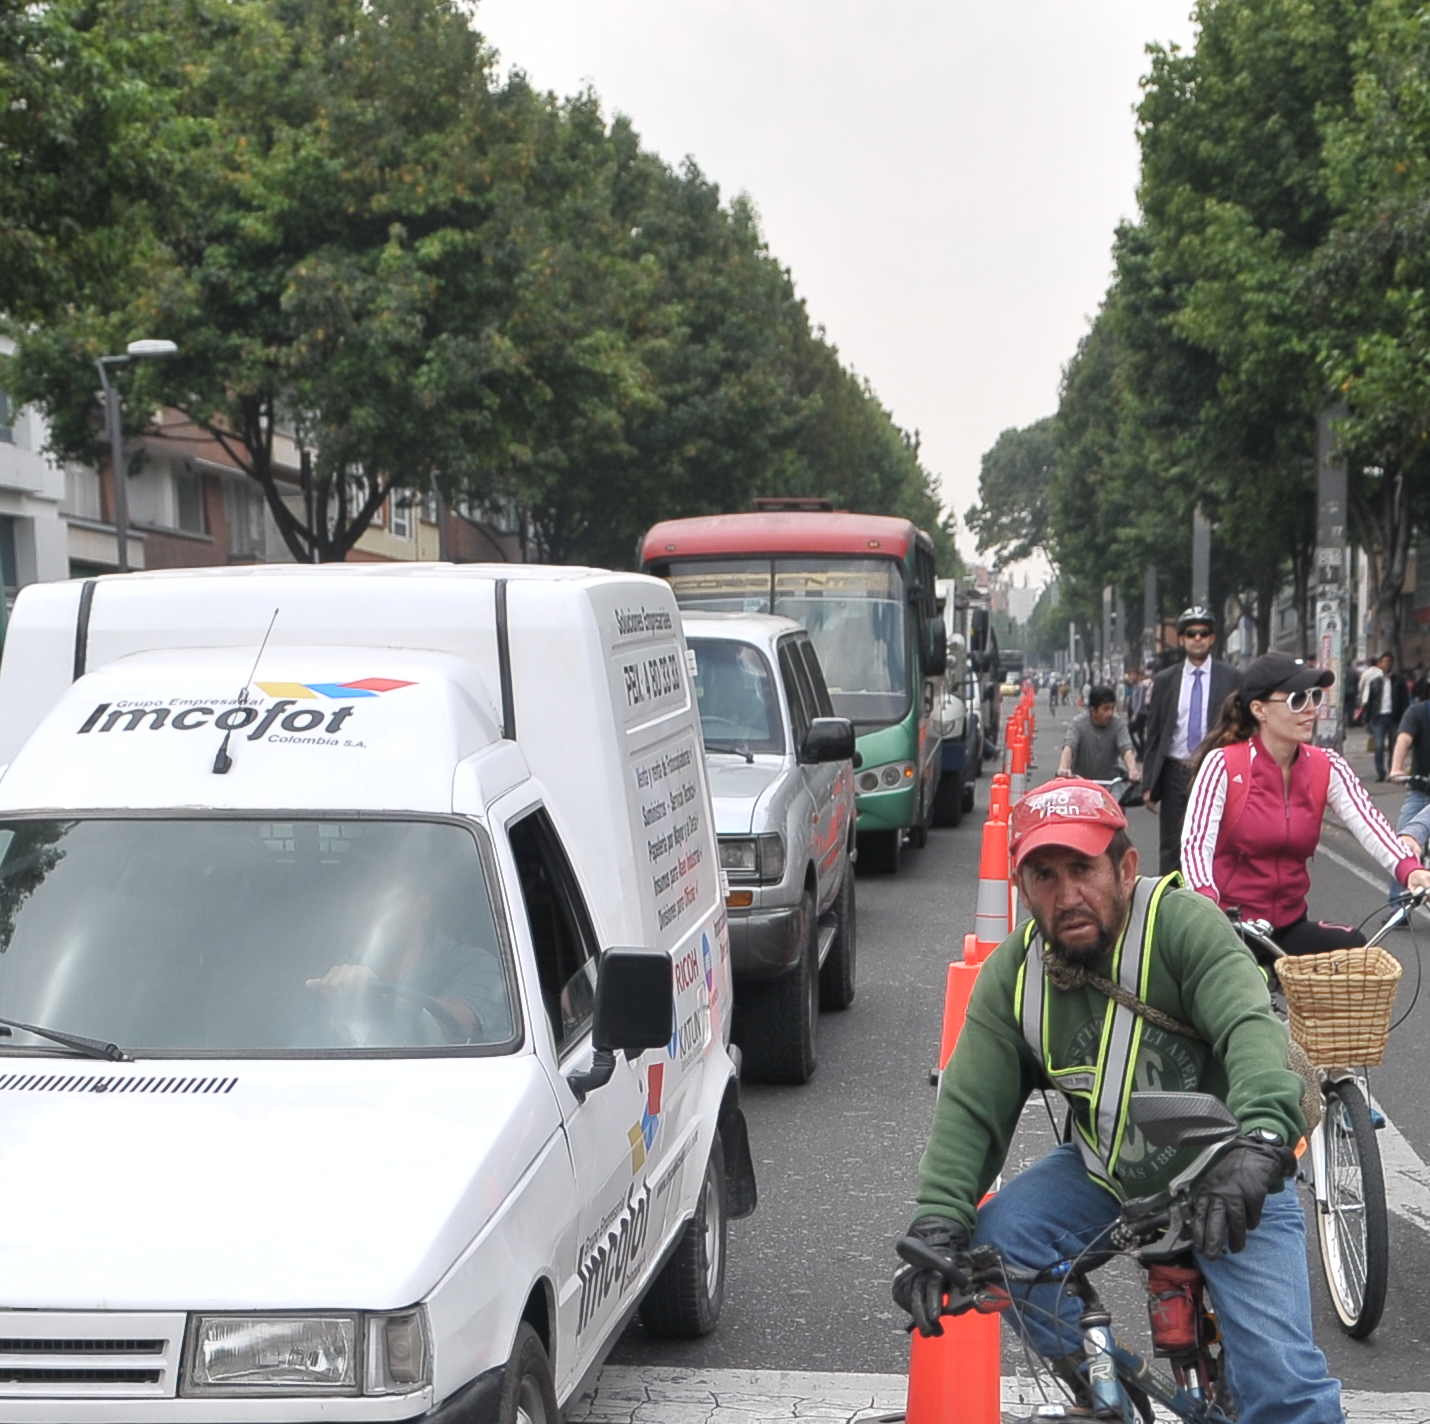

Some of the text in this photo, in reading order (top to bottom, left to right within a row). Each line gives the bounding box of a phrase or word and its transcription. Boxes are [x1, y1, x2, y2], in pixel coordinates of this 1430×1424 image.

[76, 700, 355, 741] Imcofot
[116, 699, 164, 709] Grupo
[267, 734, 339, 747] Colombia
[675, 948, 699, 995] RICOH
[678, 1010, 702, 1059] KATUN
